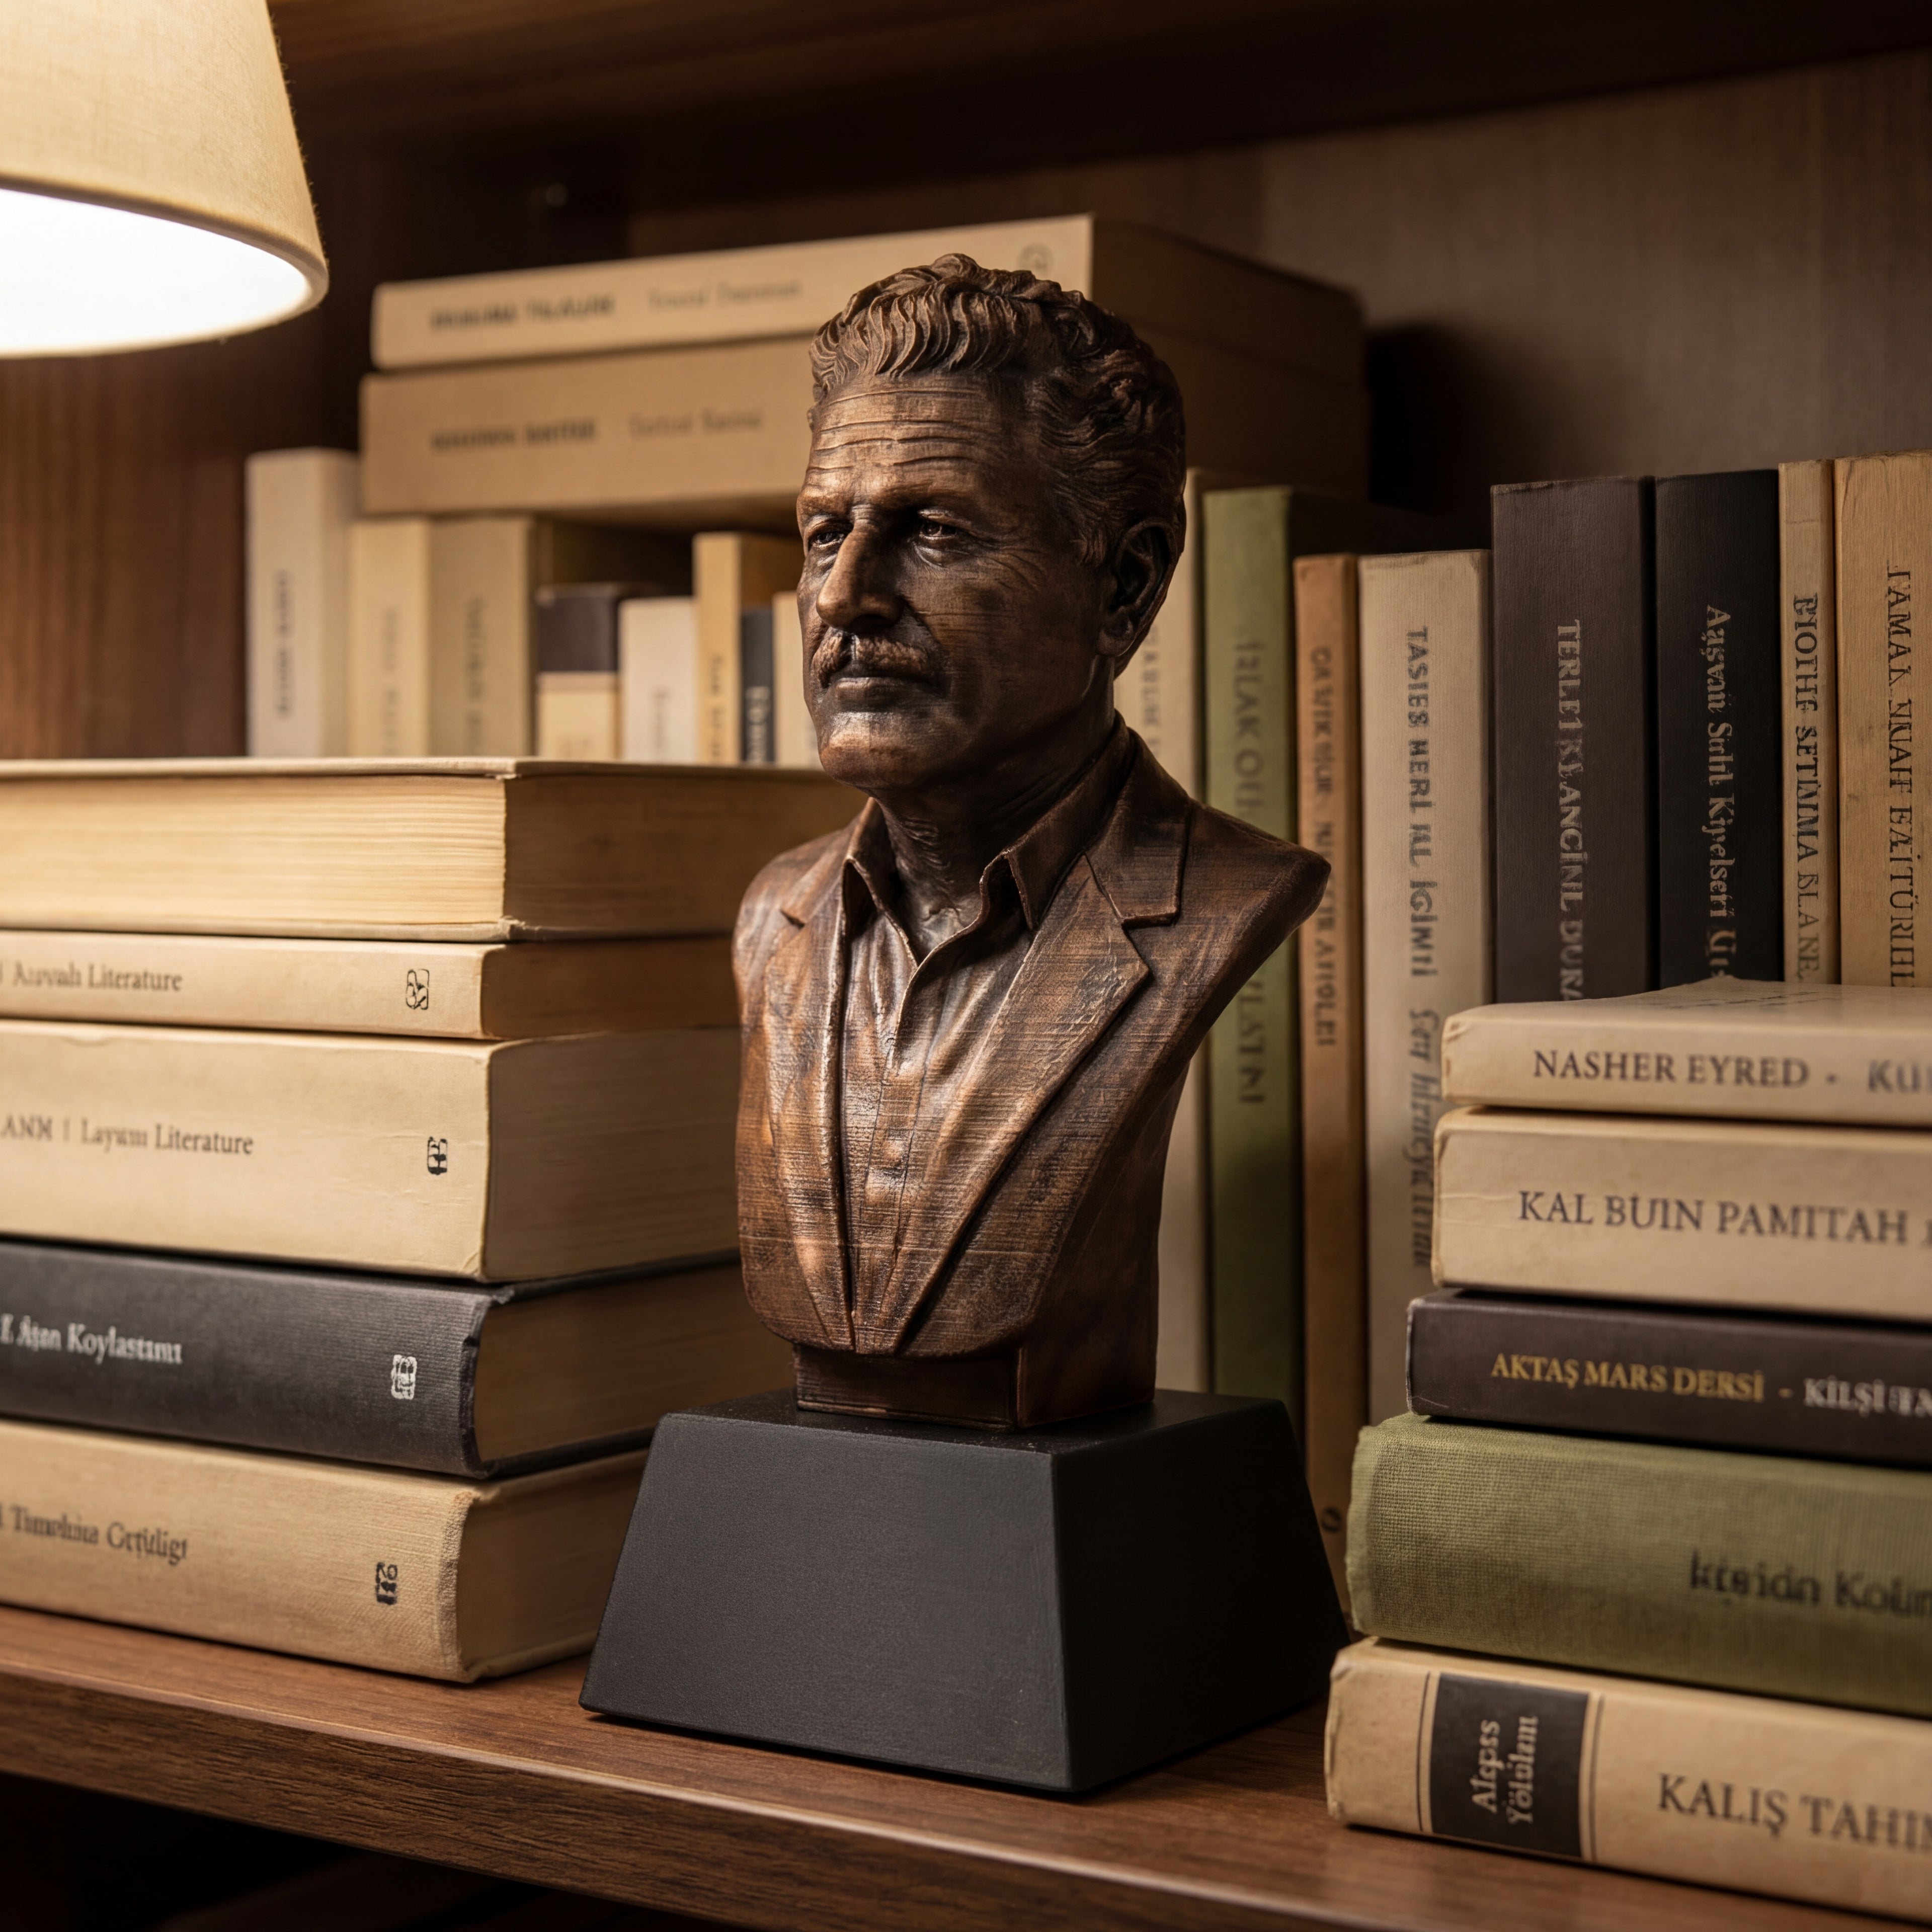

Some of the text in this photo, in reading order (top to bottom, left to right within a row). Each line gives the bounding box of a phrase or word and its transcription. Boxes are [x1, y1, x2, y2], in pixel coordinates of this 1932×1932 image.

[88, 963, 183, 991] Literature
[1533, 1050, 1676, 1083] NASHER
[1686, 1053, 1809, 1088] EYRED
[155, 1123, 254, 1155] Literature
[1518, 1190, 1594, 1225] KAL
[1491, 1353, 1580, 1389] AKTAŞ
[1583, 1360, 1668, 1392] MARS
[1658, 1772, 1789, 1838] KALIŞ
